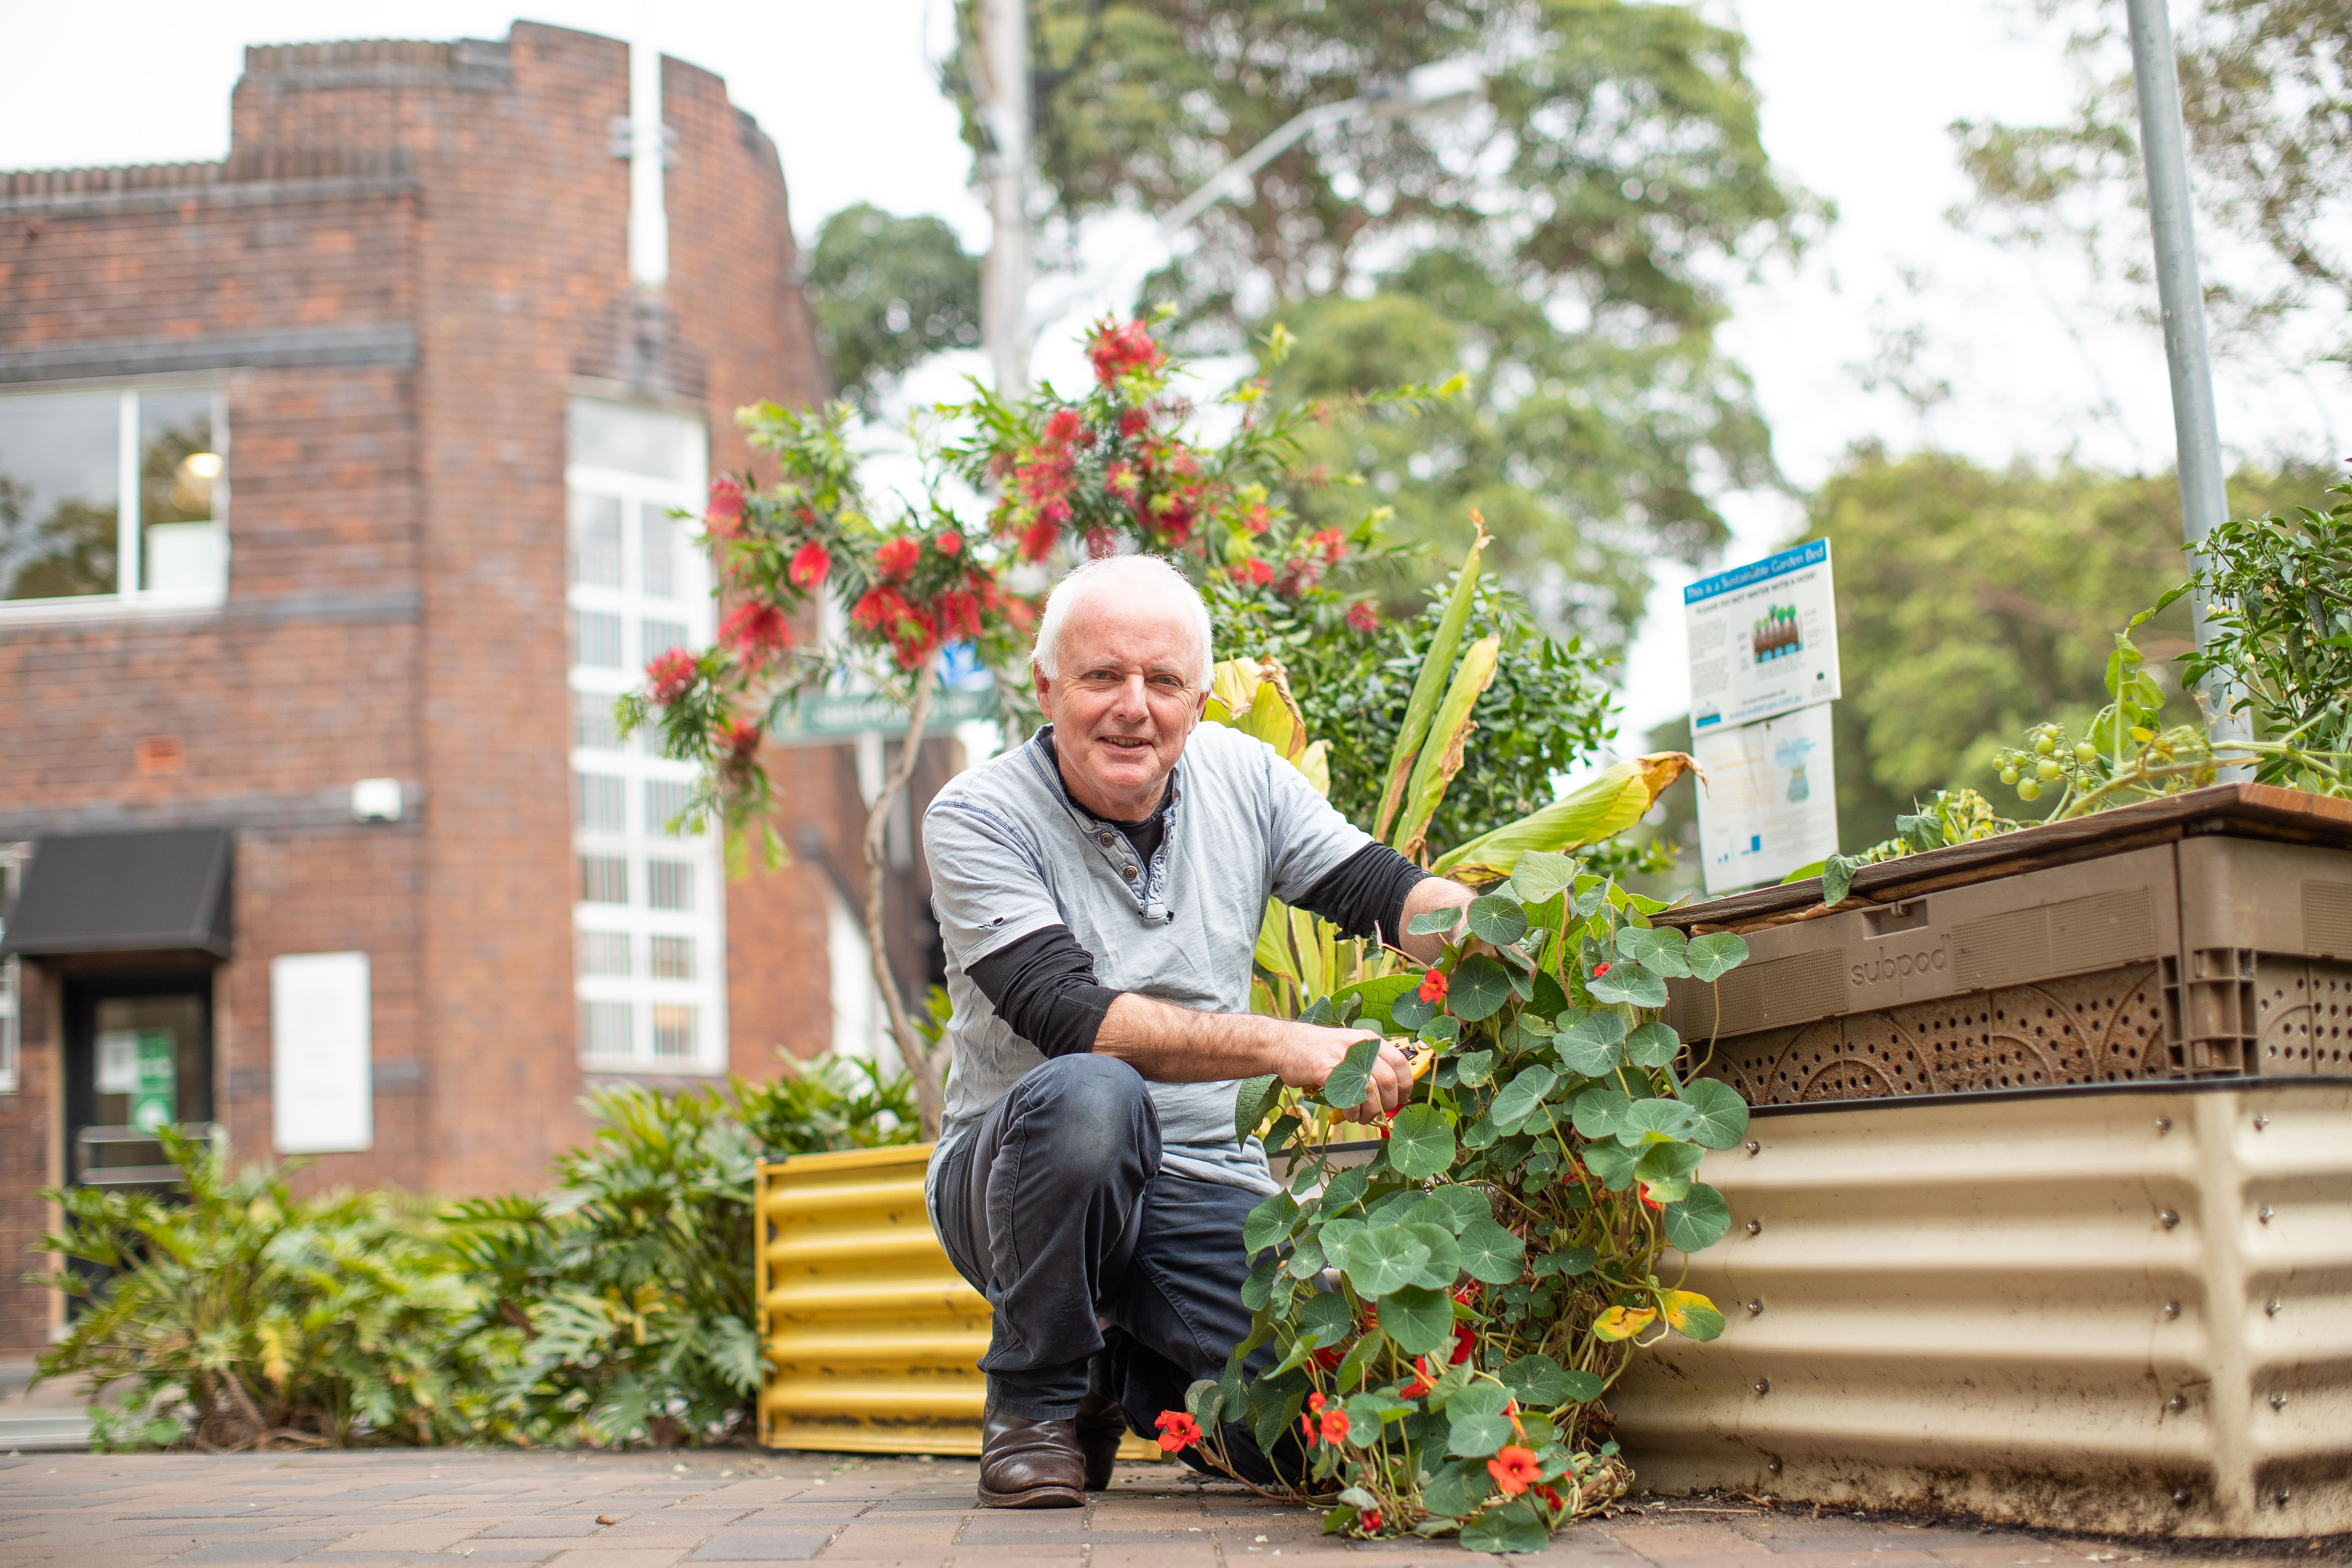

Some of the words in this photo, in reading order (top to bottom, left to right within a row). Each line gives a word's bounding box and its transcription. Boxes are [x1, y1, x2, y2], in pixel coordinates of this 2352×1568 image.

[1686, 587, 1703, 599] This
[1706, 584, 1712, 594] is
[1771, 554, 1804, 573] Garden
[1805, 545, 1824, 562] Bed
